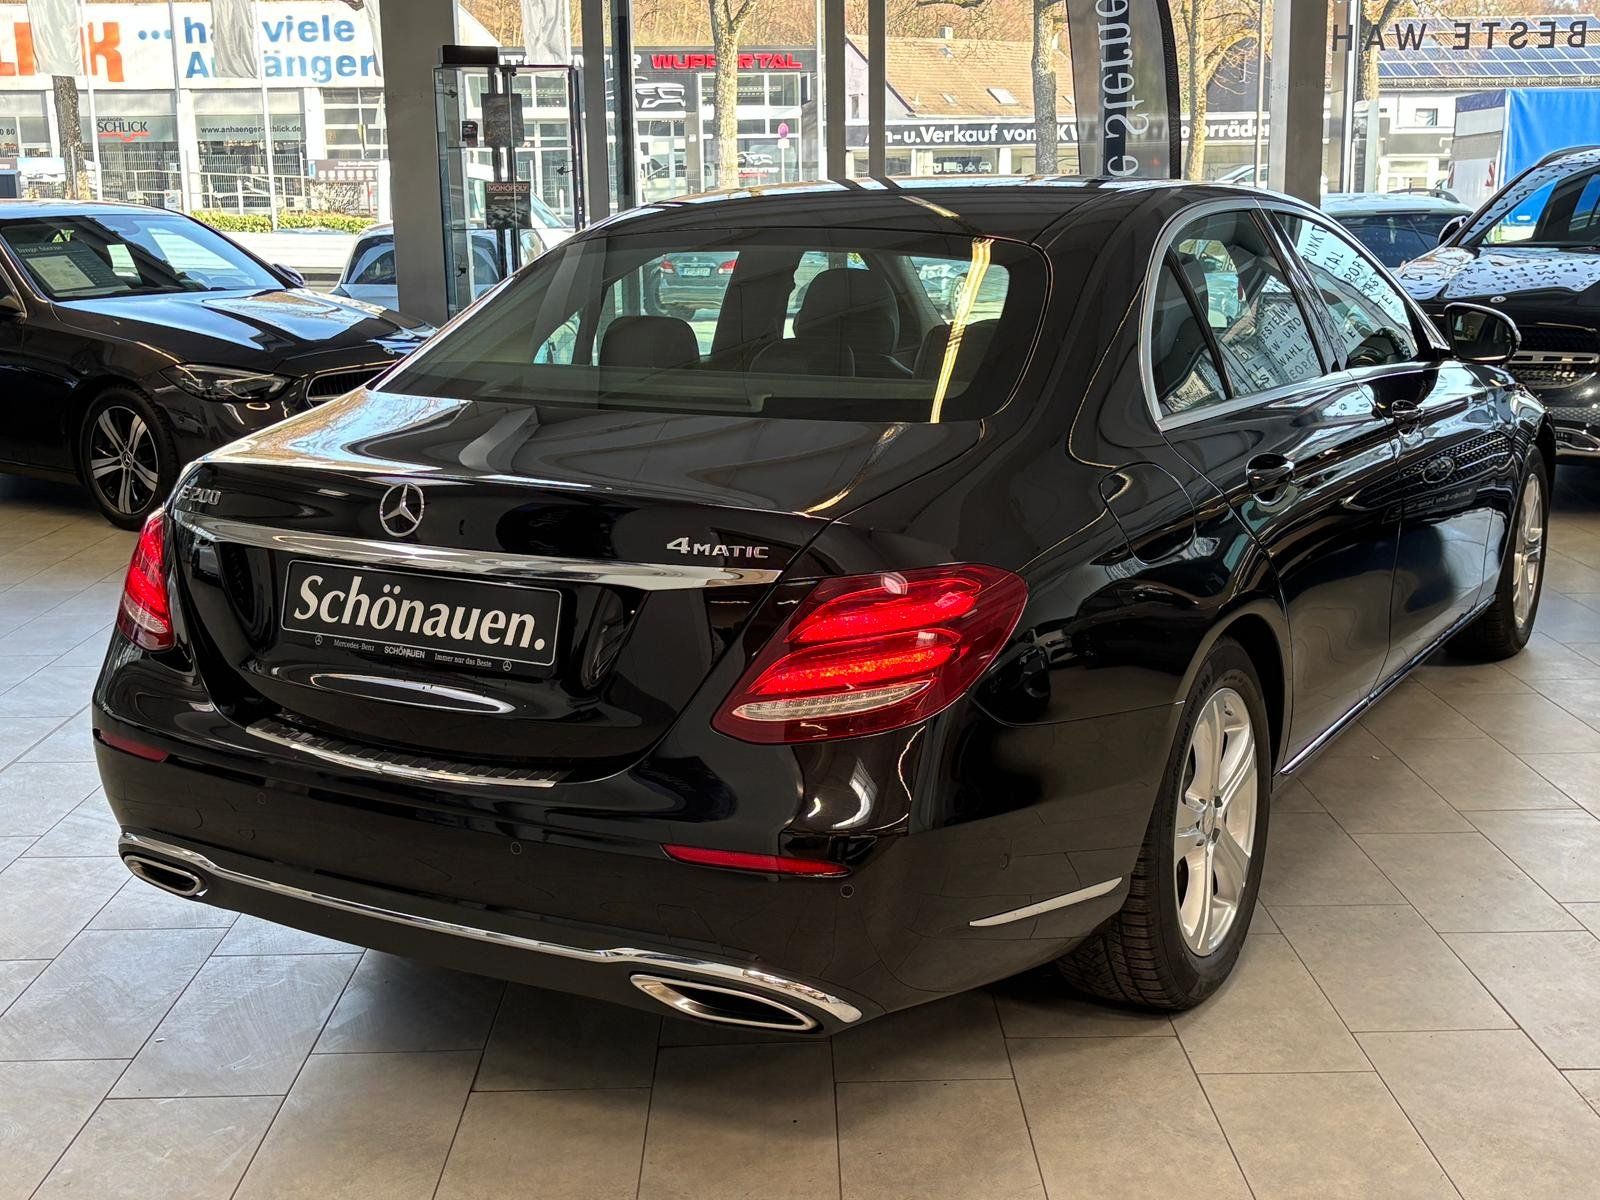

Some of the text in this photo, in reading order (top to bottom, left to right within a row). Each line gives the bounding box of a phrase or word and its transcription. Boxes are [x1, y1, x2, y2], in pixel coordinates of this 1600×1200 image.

[261, 14, 355, 42] viele
[185, 50, 377, 83] Aänger
[651, 53, 803, 69] WUPPRTAL
[97, 121, 148, 133] SCHLICK
[200, 125, 302, 135] www.anhaenger-hlick.de
[487, 183, 529, 193] MONOPOLY
[666, 536, 769, 559] 4MATIC
[293, 574, 546, 651] Schönauen.
[333, 638, 375, 652] Mercedes-Benz
[384, 644, 426, 659] SCHÖNAUEN
[434, 652, 453, 662] Immer
[465, 657, 476, 666] das
[476, 659, 492, 668] Beste
